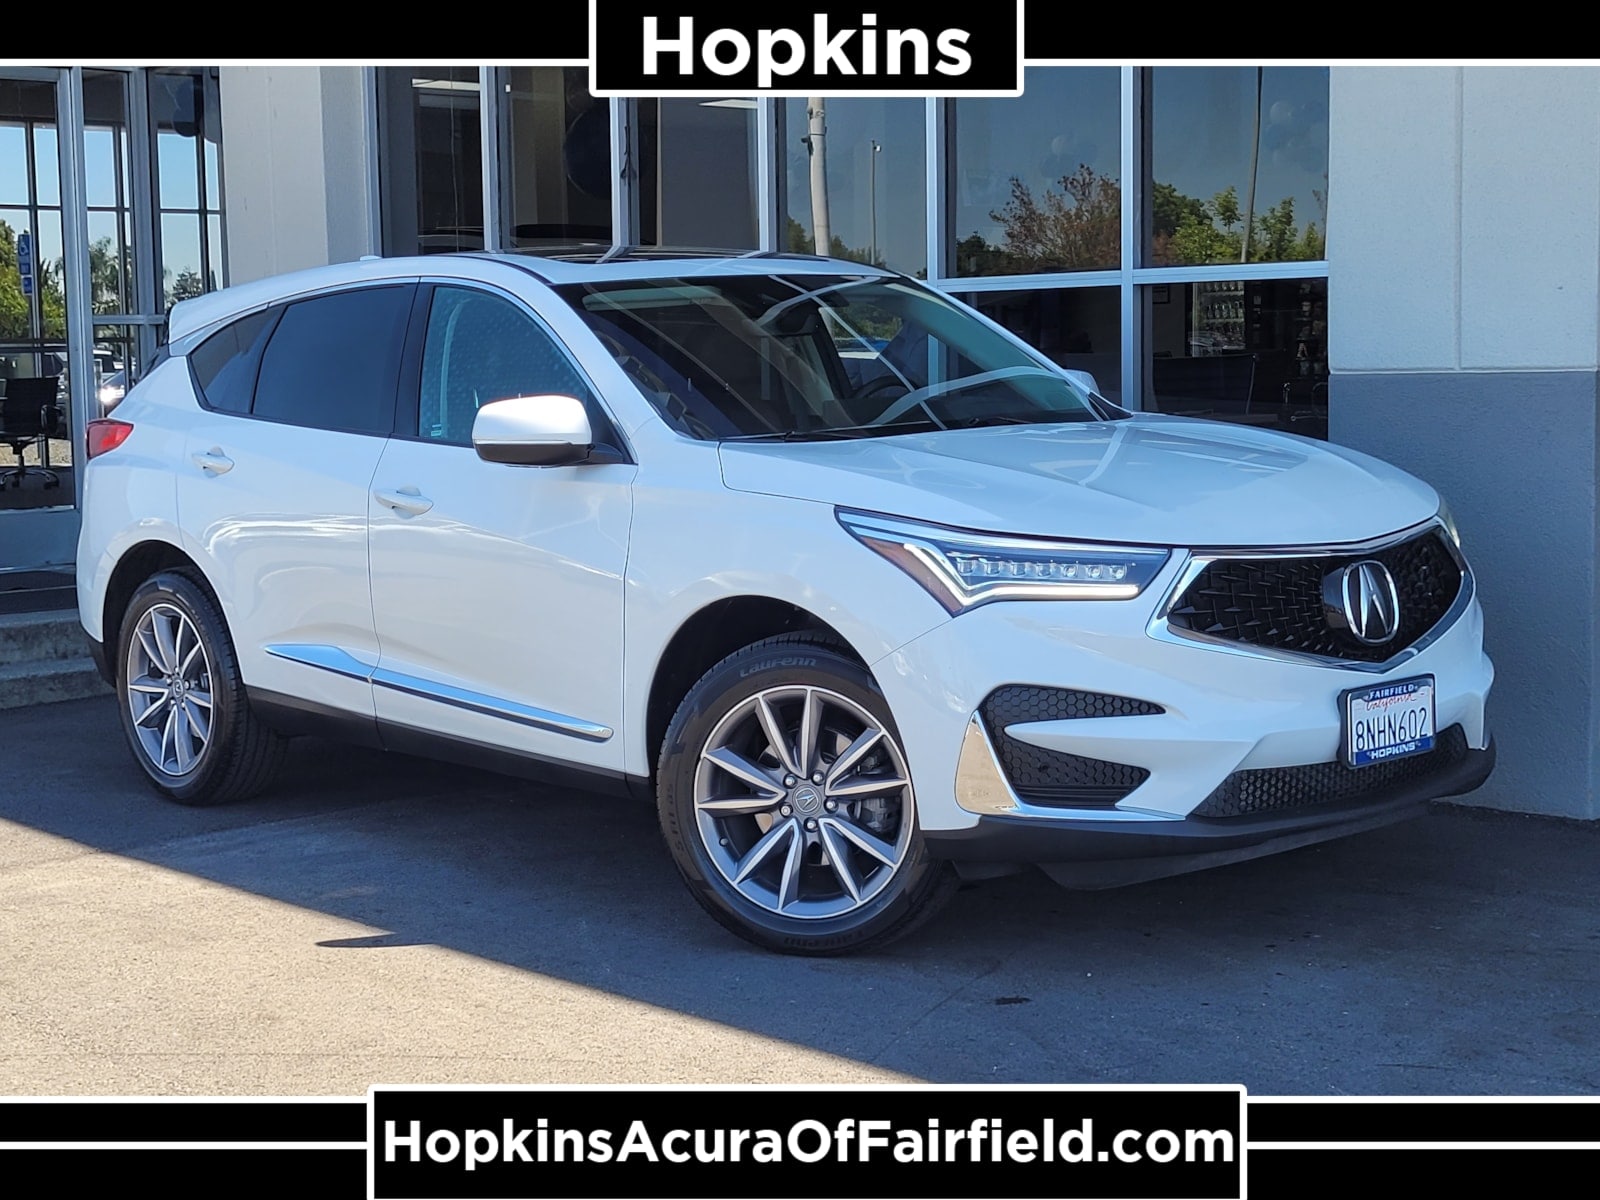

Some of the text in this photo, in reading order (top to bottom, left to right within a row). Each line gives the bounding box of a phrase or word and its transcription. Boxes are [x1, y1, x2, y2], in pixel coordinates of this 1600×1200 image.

[1369, 683, 1414, 701] FAIRFIELD
[1356, 707, 1428, 751] 8NHN602
[1371, 742, 1416, 760] HOPKINS
